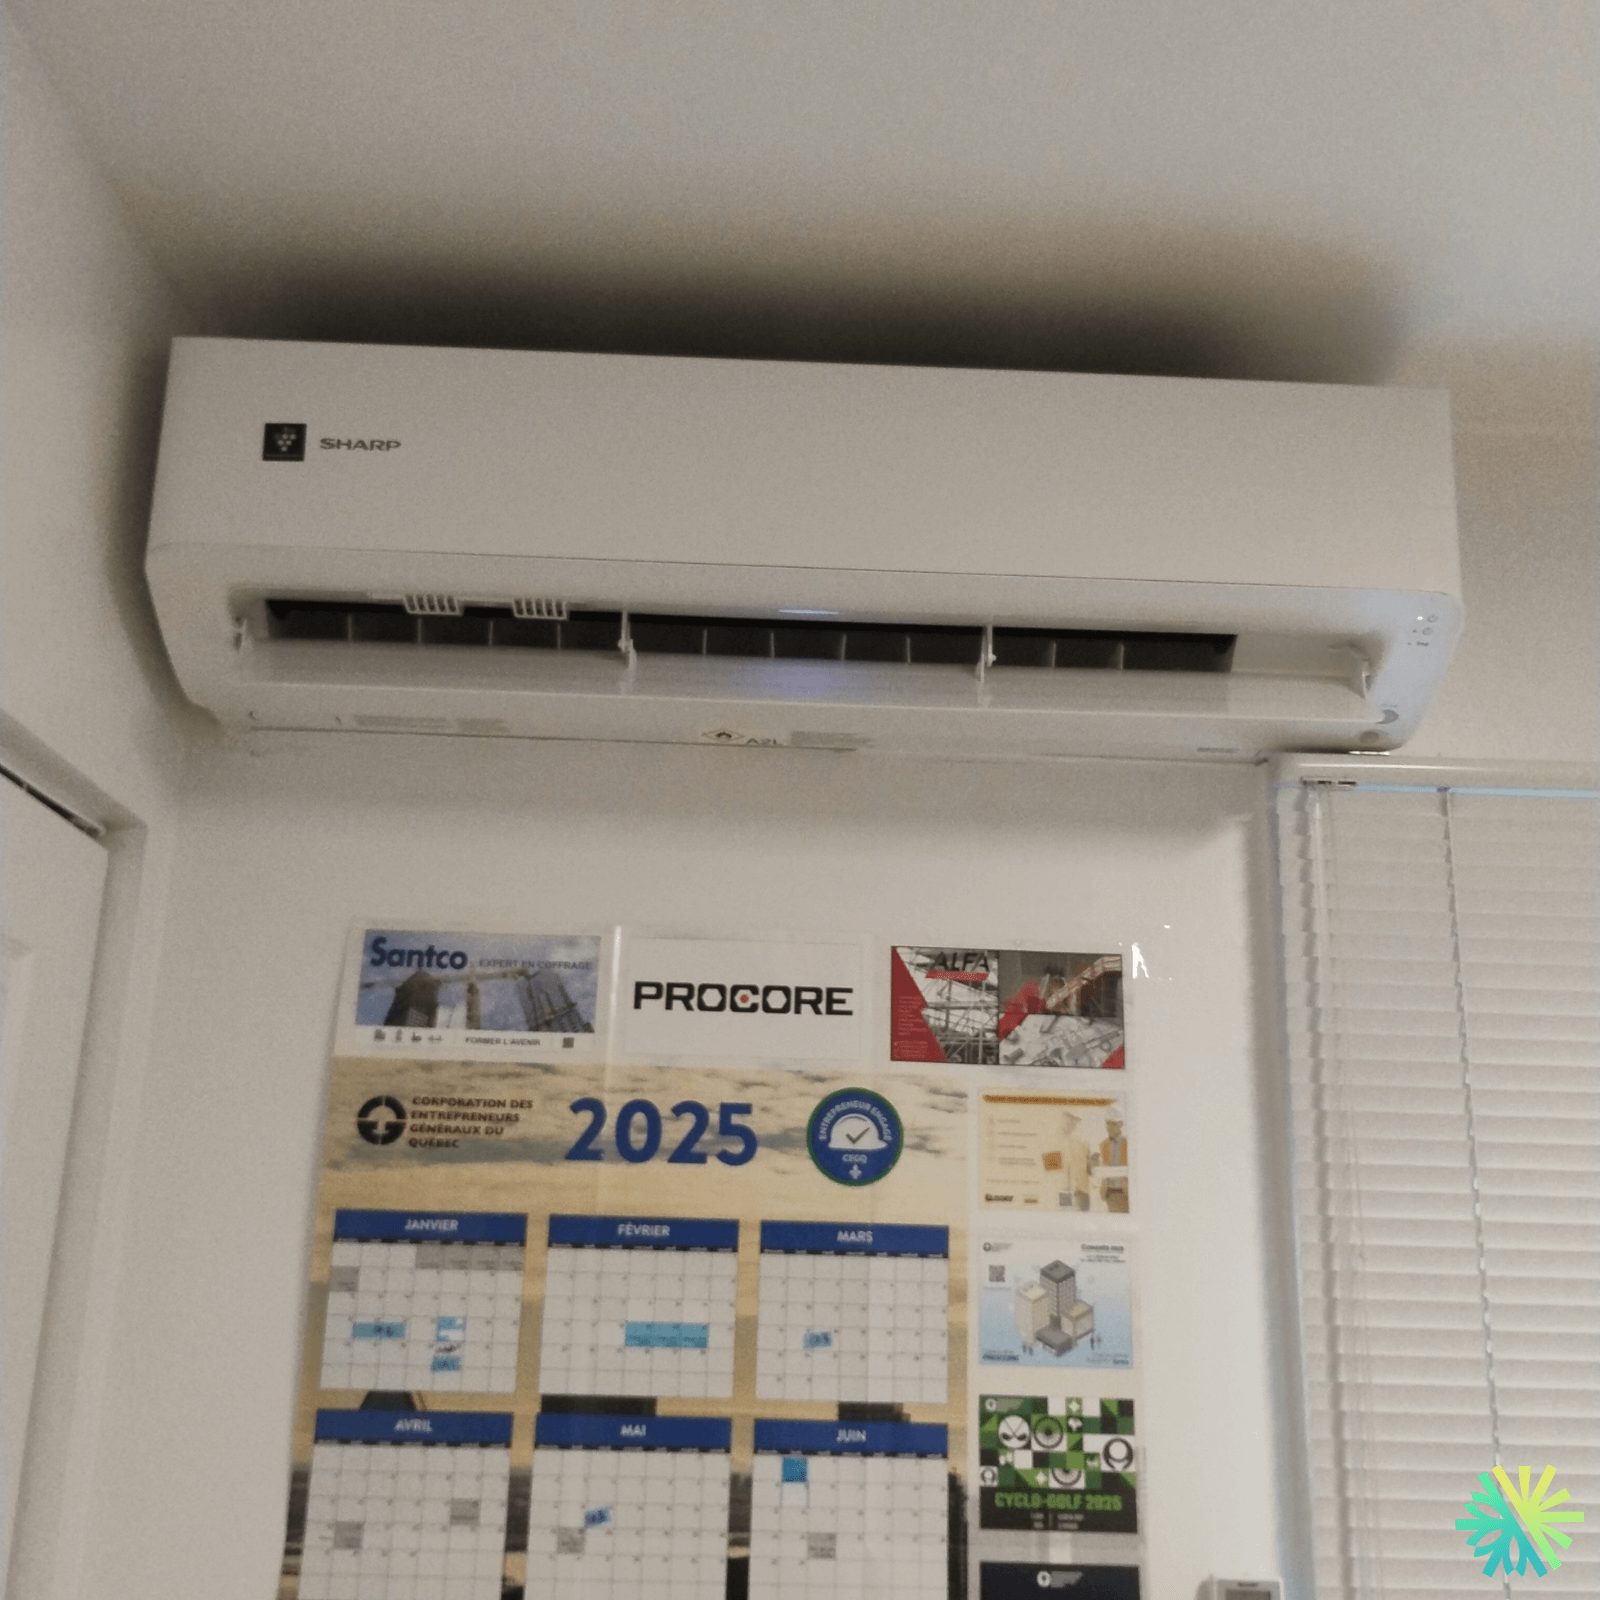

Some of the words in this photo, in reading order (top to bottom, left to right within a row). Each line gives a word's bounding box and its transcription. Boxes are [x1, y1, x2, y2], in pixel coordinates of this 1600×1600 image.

[319, 438, 402, 451] SHARP
[369, 936, 468, 970] Santco
[479, 958, 518, 969] EXPERT
[521, 959, 535, 969] EN
[537, 959, 594, 971] COFFRAGE
[930, 951, 991, 972] ALFA
[633, 981, 853, 1016] PROCORE
[412, 1096, 507, 1109] CORPORATION
[510, 1099, 534, 1110] DES
[410, 1110, 521, 1123] ENTREPRENEURS
[818, 1100, 871, 1141] ENTREPRENEUR
[410, 1121, 482, 1135] GÉNÉRAUX
[485, 1125, 504, 1136] DU
[564, 1097, 759, 1166] 2025
[408, 1136, 460, 1149] QUÉBEC
[404, 1218, 459, 1232] JANVIER
[617, 1221, 671, 1237] FÉVRIER
[836, 1230, 874, 1243] MARS
[393, 1418, 433, 1433] AVRIL
[620, 1423, 647, 1437] MAI
[835, 1429, 867, 1443] JUIN
